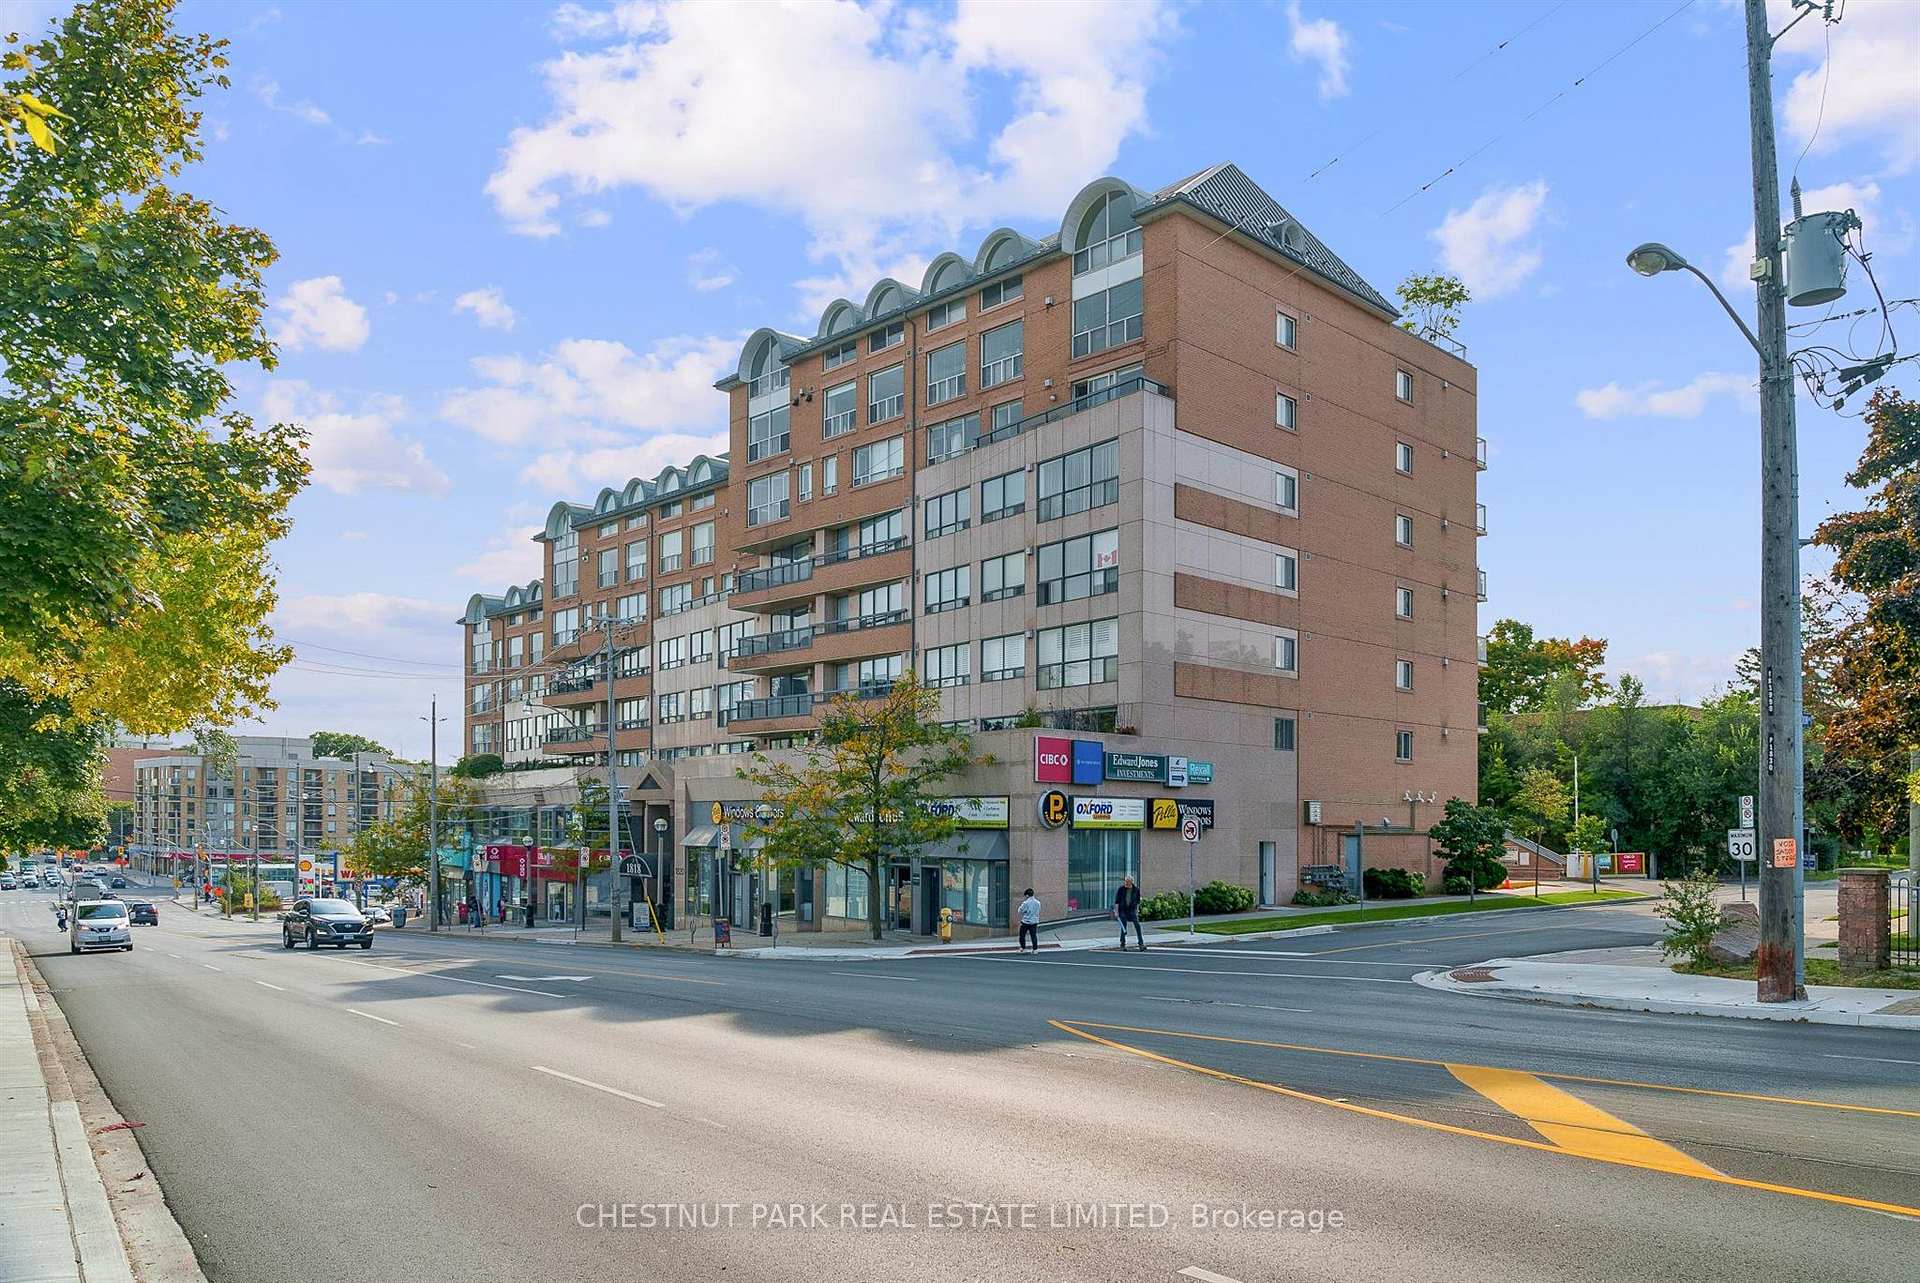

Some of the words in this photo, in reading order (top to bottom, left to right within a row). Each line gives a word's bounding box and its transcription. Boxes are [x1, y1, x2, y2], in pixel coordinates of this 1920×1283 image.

[1040, 753, 1060, 765] CIBC
[1116, 769, 1155, 779] INVESTMENTS
[1077, 800, 1113, 815] OXFORD
[1732, 843, 1752, 856] 30
[341, 870, 373, 878] WAH
[626, 863, 642, 874] 1818
